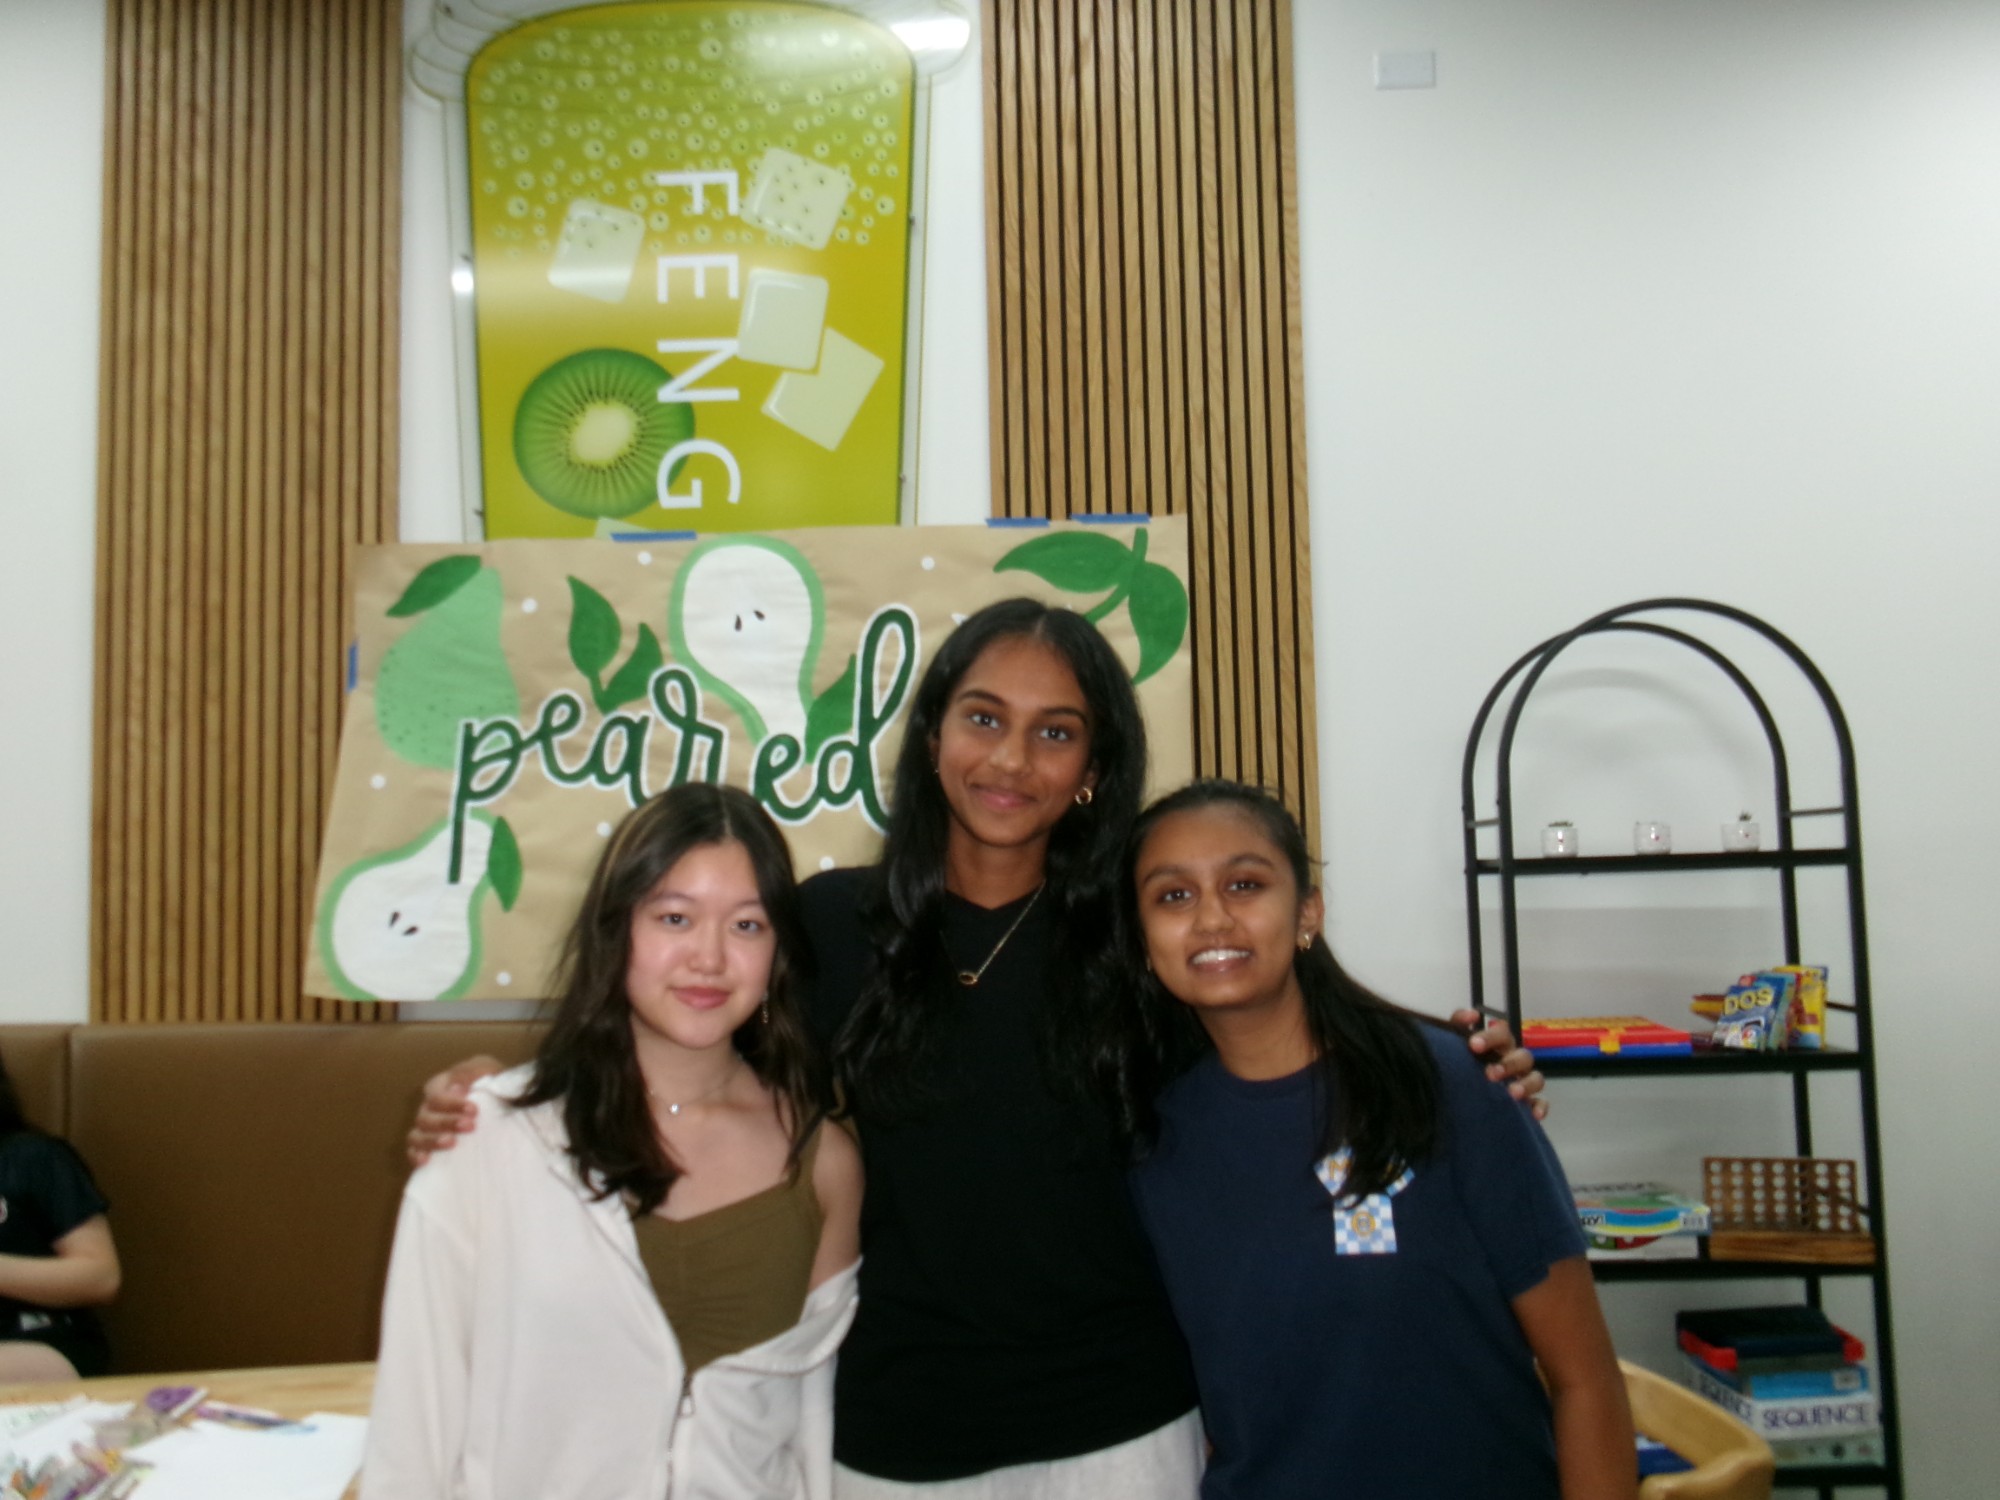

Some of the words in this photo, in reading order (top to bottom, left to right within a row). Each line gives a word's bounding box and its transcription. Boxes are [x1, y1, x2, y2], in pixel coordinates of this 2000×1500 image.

[656, 170, 742, 510] FENG
[1724, 986, 1774, 1016] DOS
[1762, 1402, 1868, 1431] SEQUENCE
